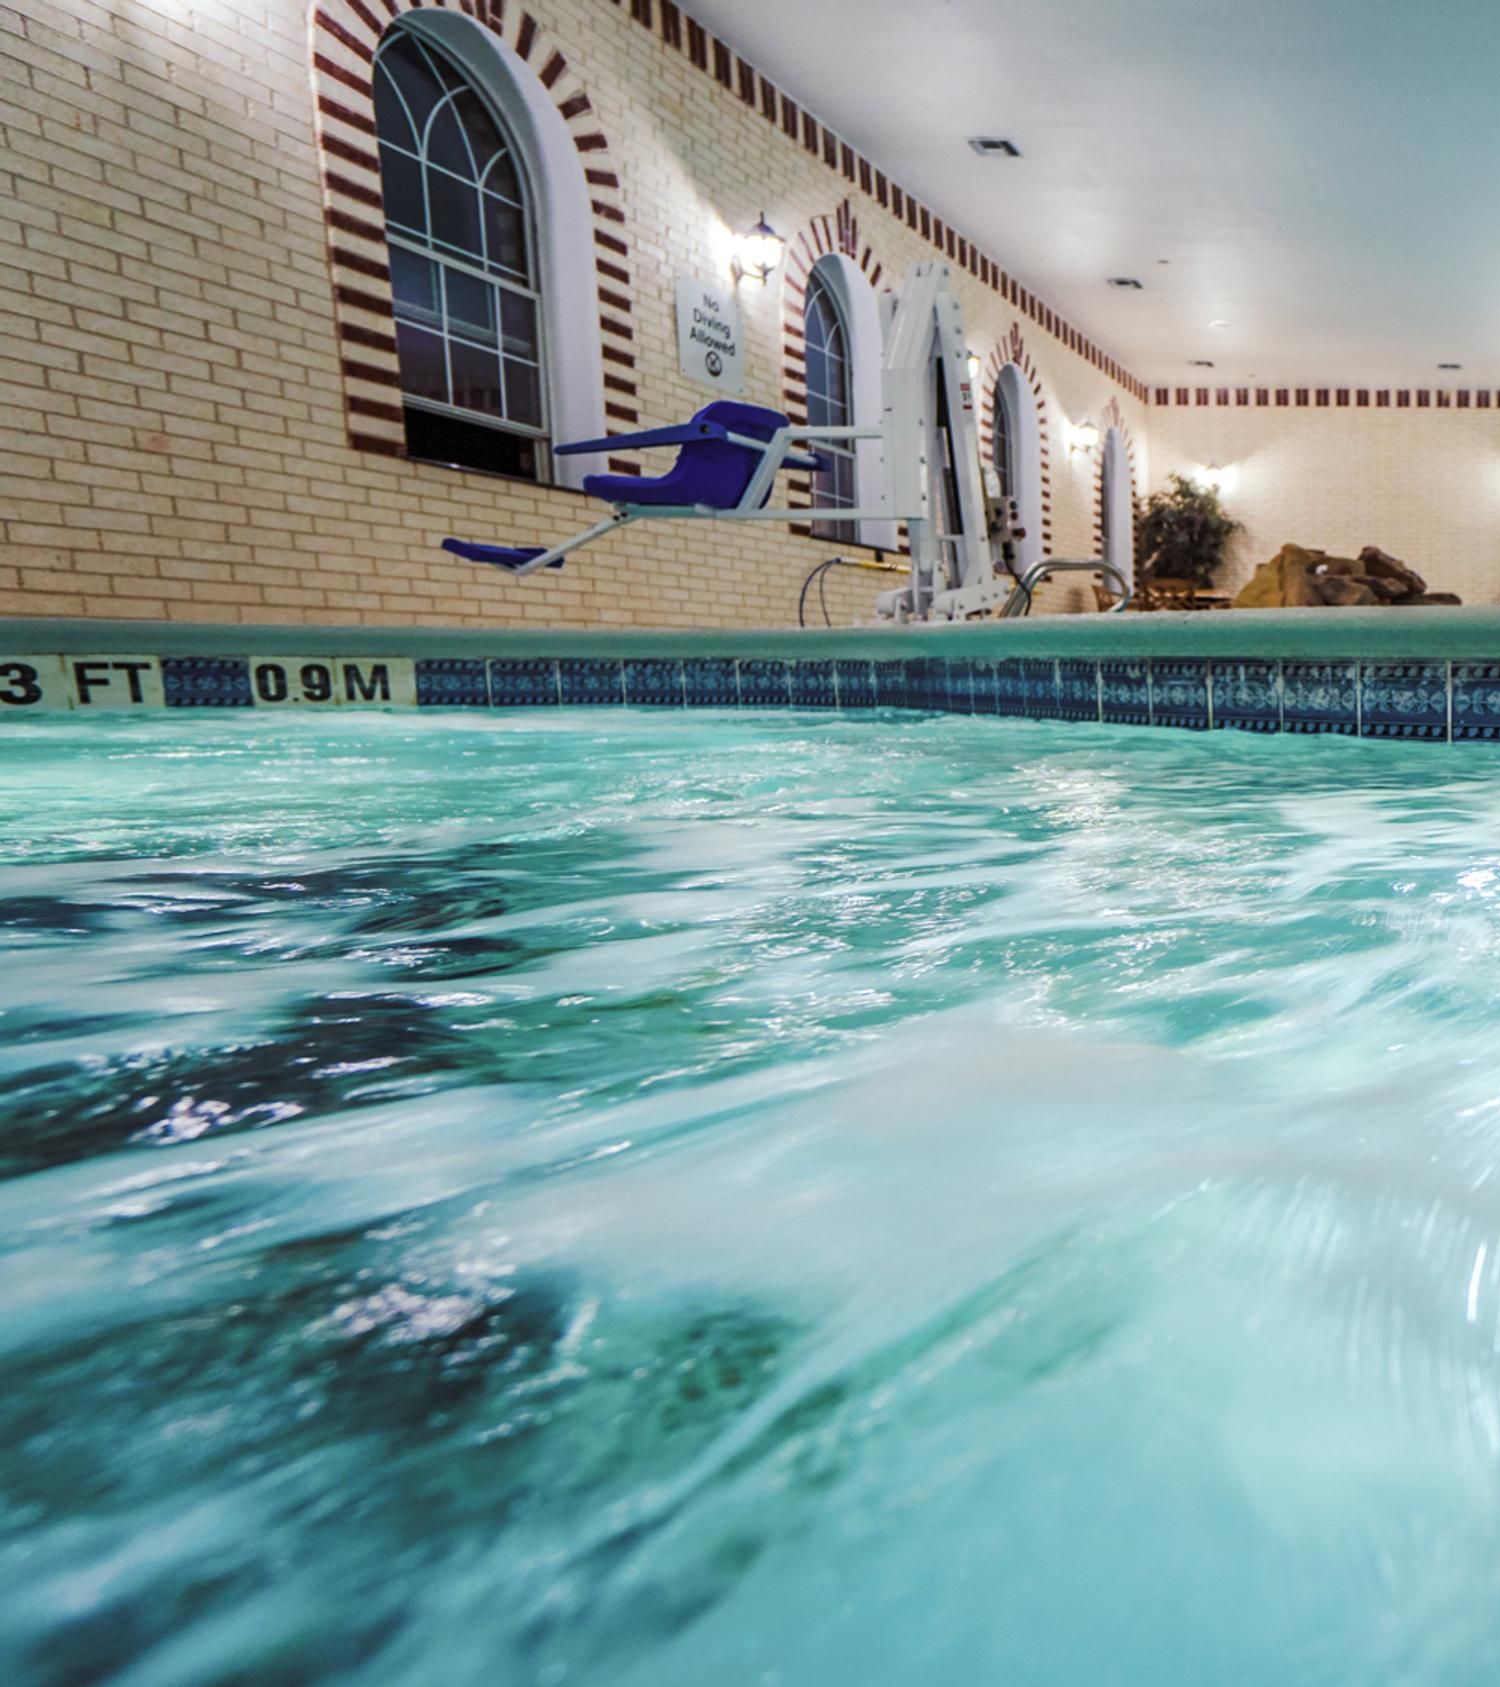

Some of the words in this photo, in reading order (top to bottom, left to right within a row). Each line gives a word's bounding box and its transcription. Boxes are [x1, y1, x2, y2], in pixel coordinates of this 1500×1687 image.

[703, 293, 719, 312] No
[693, 307, 731, 339] Diving
[690, 326, 735, 357] Allowed
[0, 663, 42, 705] 3
[72, 662, 151, 704] FT
